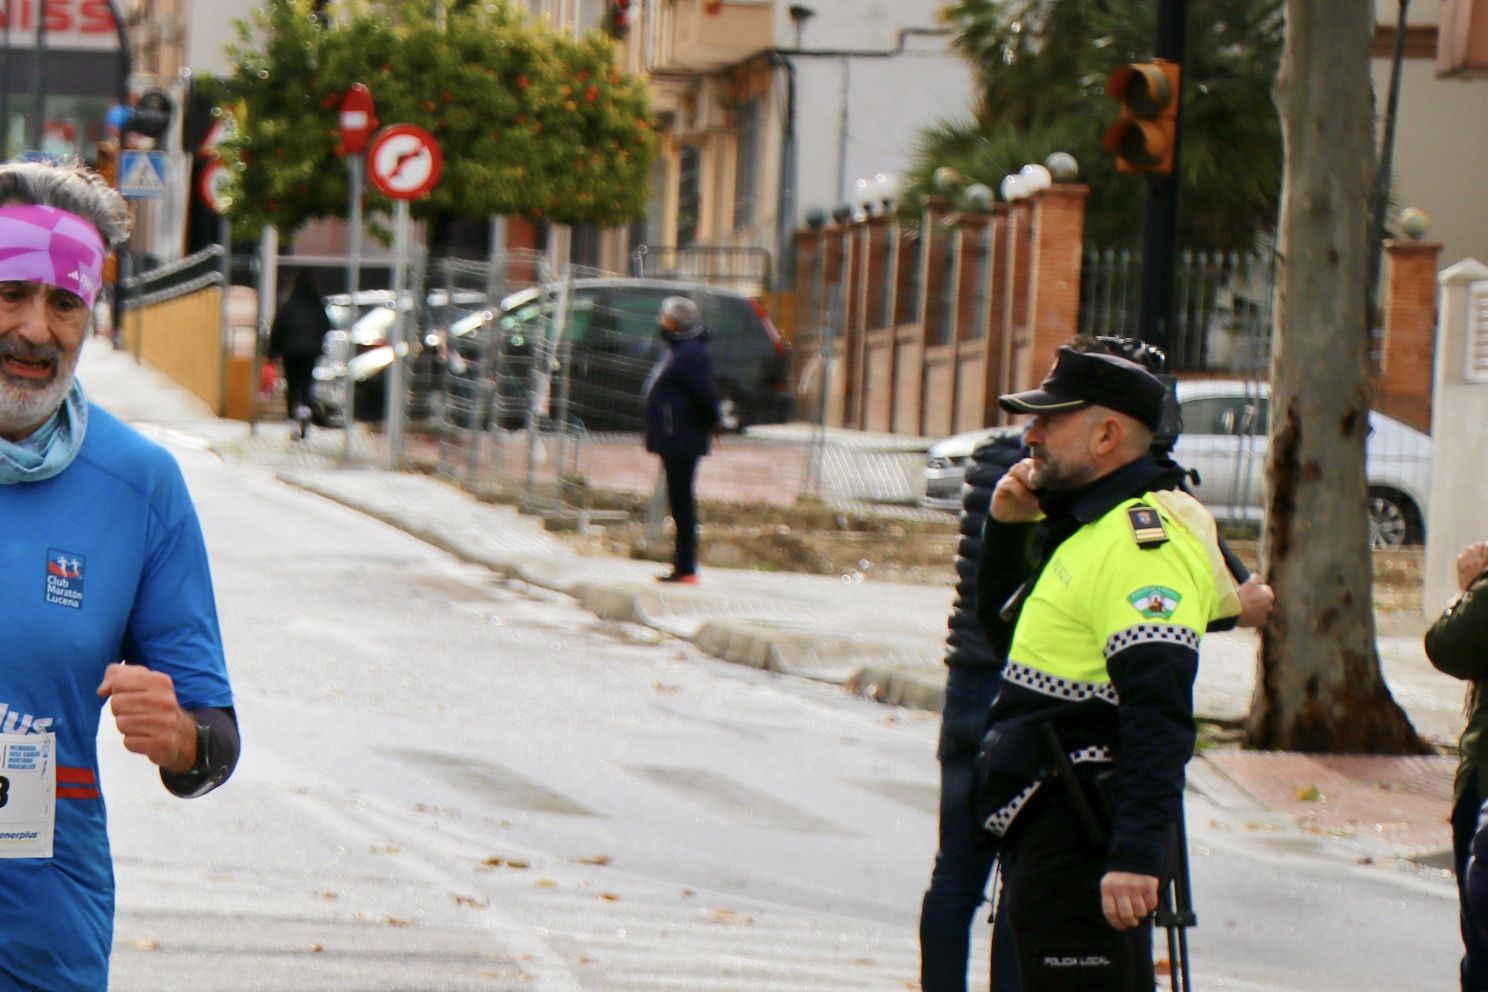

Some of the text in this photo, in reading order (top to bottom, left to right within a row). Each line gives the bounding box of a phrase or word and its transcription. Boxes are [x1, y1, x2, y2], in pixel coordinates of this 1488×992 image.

[47, 575, 69, 588] Club
[46, 592, 79, 608] Lucena
[47, 584, 83, 600] Maratón
